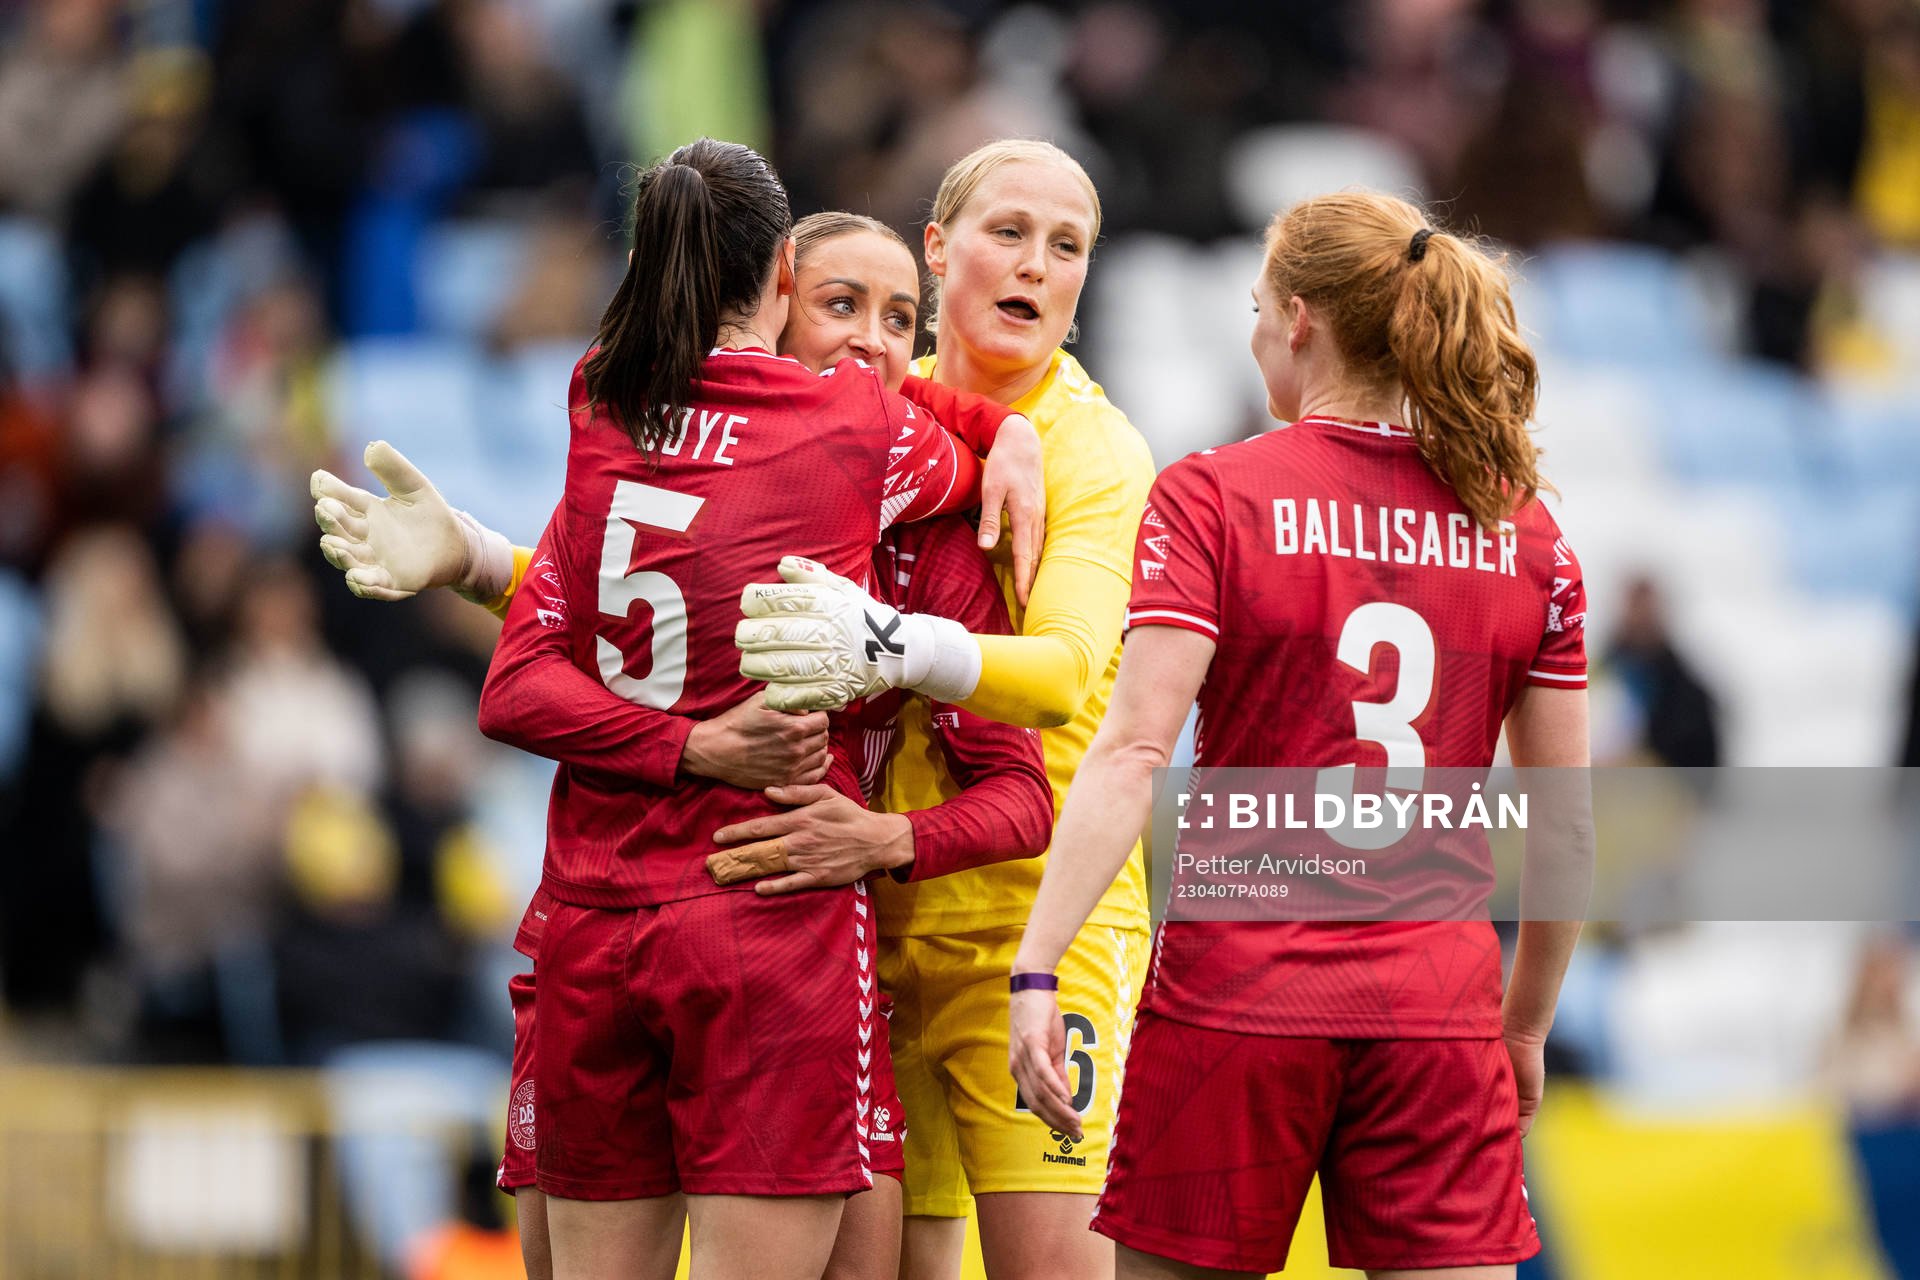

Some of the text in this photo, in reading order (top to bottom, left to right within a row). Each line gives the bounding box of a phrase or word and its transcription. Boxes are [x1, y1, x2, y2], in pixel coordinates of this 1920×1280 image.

[1273, 498, 1518, 577] BALLISAGER
[596, 479, 706, 712] 5
[1315, 602, 1436, 851] 3
[1016, 1013, 1096, 1113] 6
[1043, 1152, 1086, 1166] hummel
